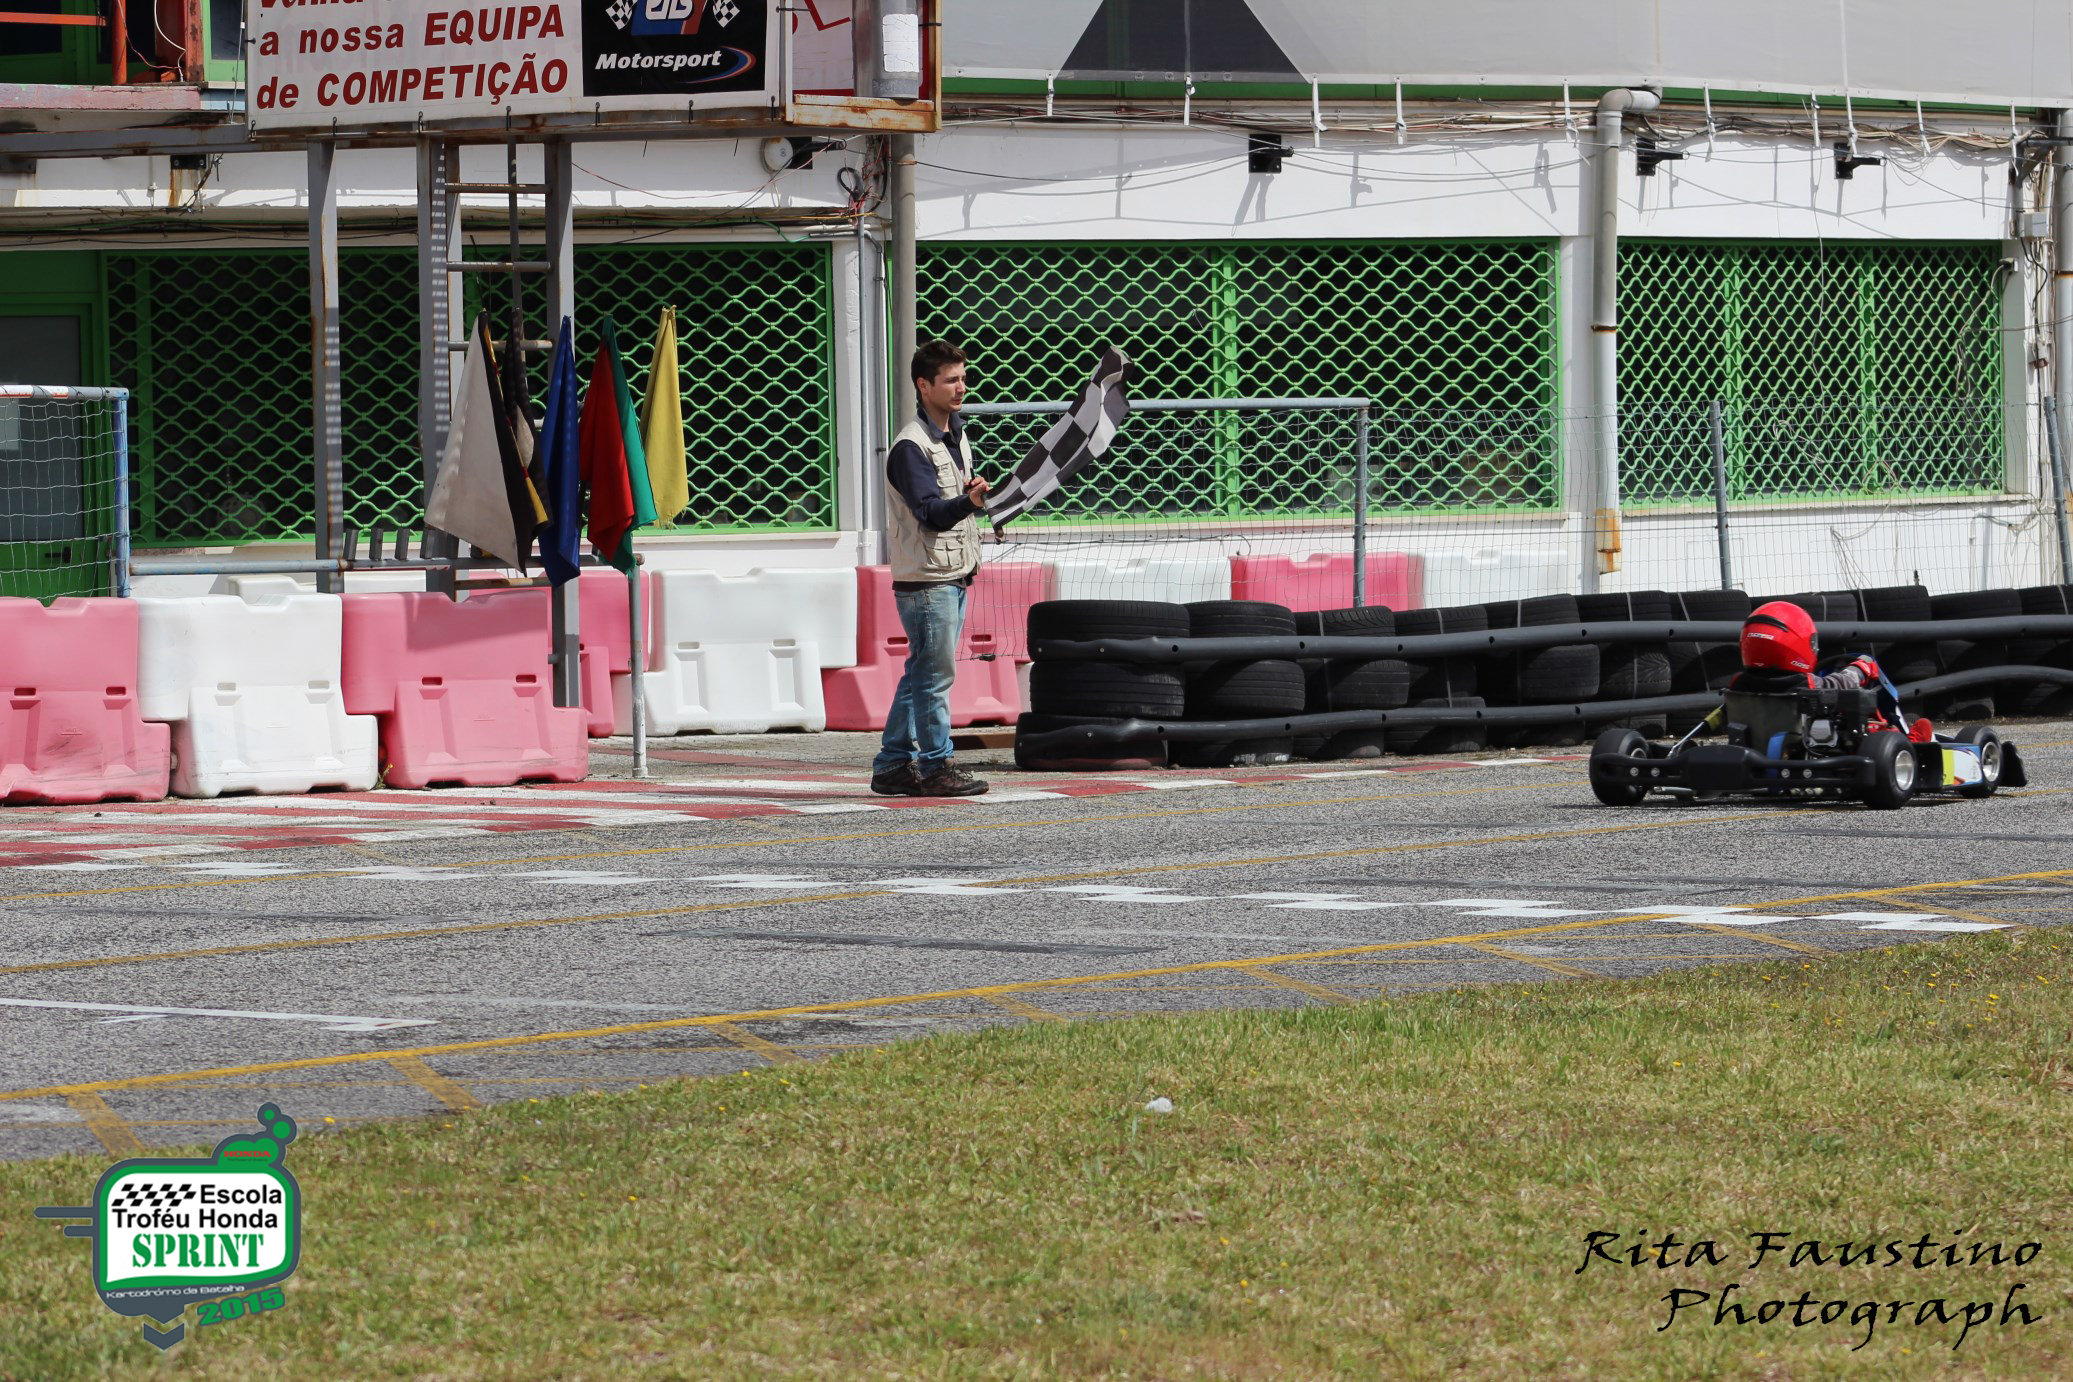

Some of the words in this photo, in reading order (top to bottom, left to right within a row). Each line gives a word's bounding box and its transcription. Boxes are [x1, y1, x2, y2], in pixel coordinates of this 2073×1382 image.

[259, 31, 279, 56] a
[299, 23, 404, 54] nossa
[424, 4, 564, 46] EQUIPA
[256, 76, 299, 109] de
[317, 52, 568, 107] COMPETIÇÃO
[595, 50, 722, 71] Motorsport
